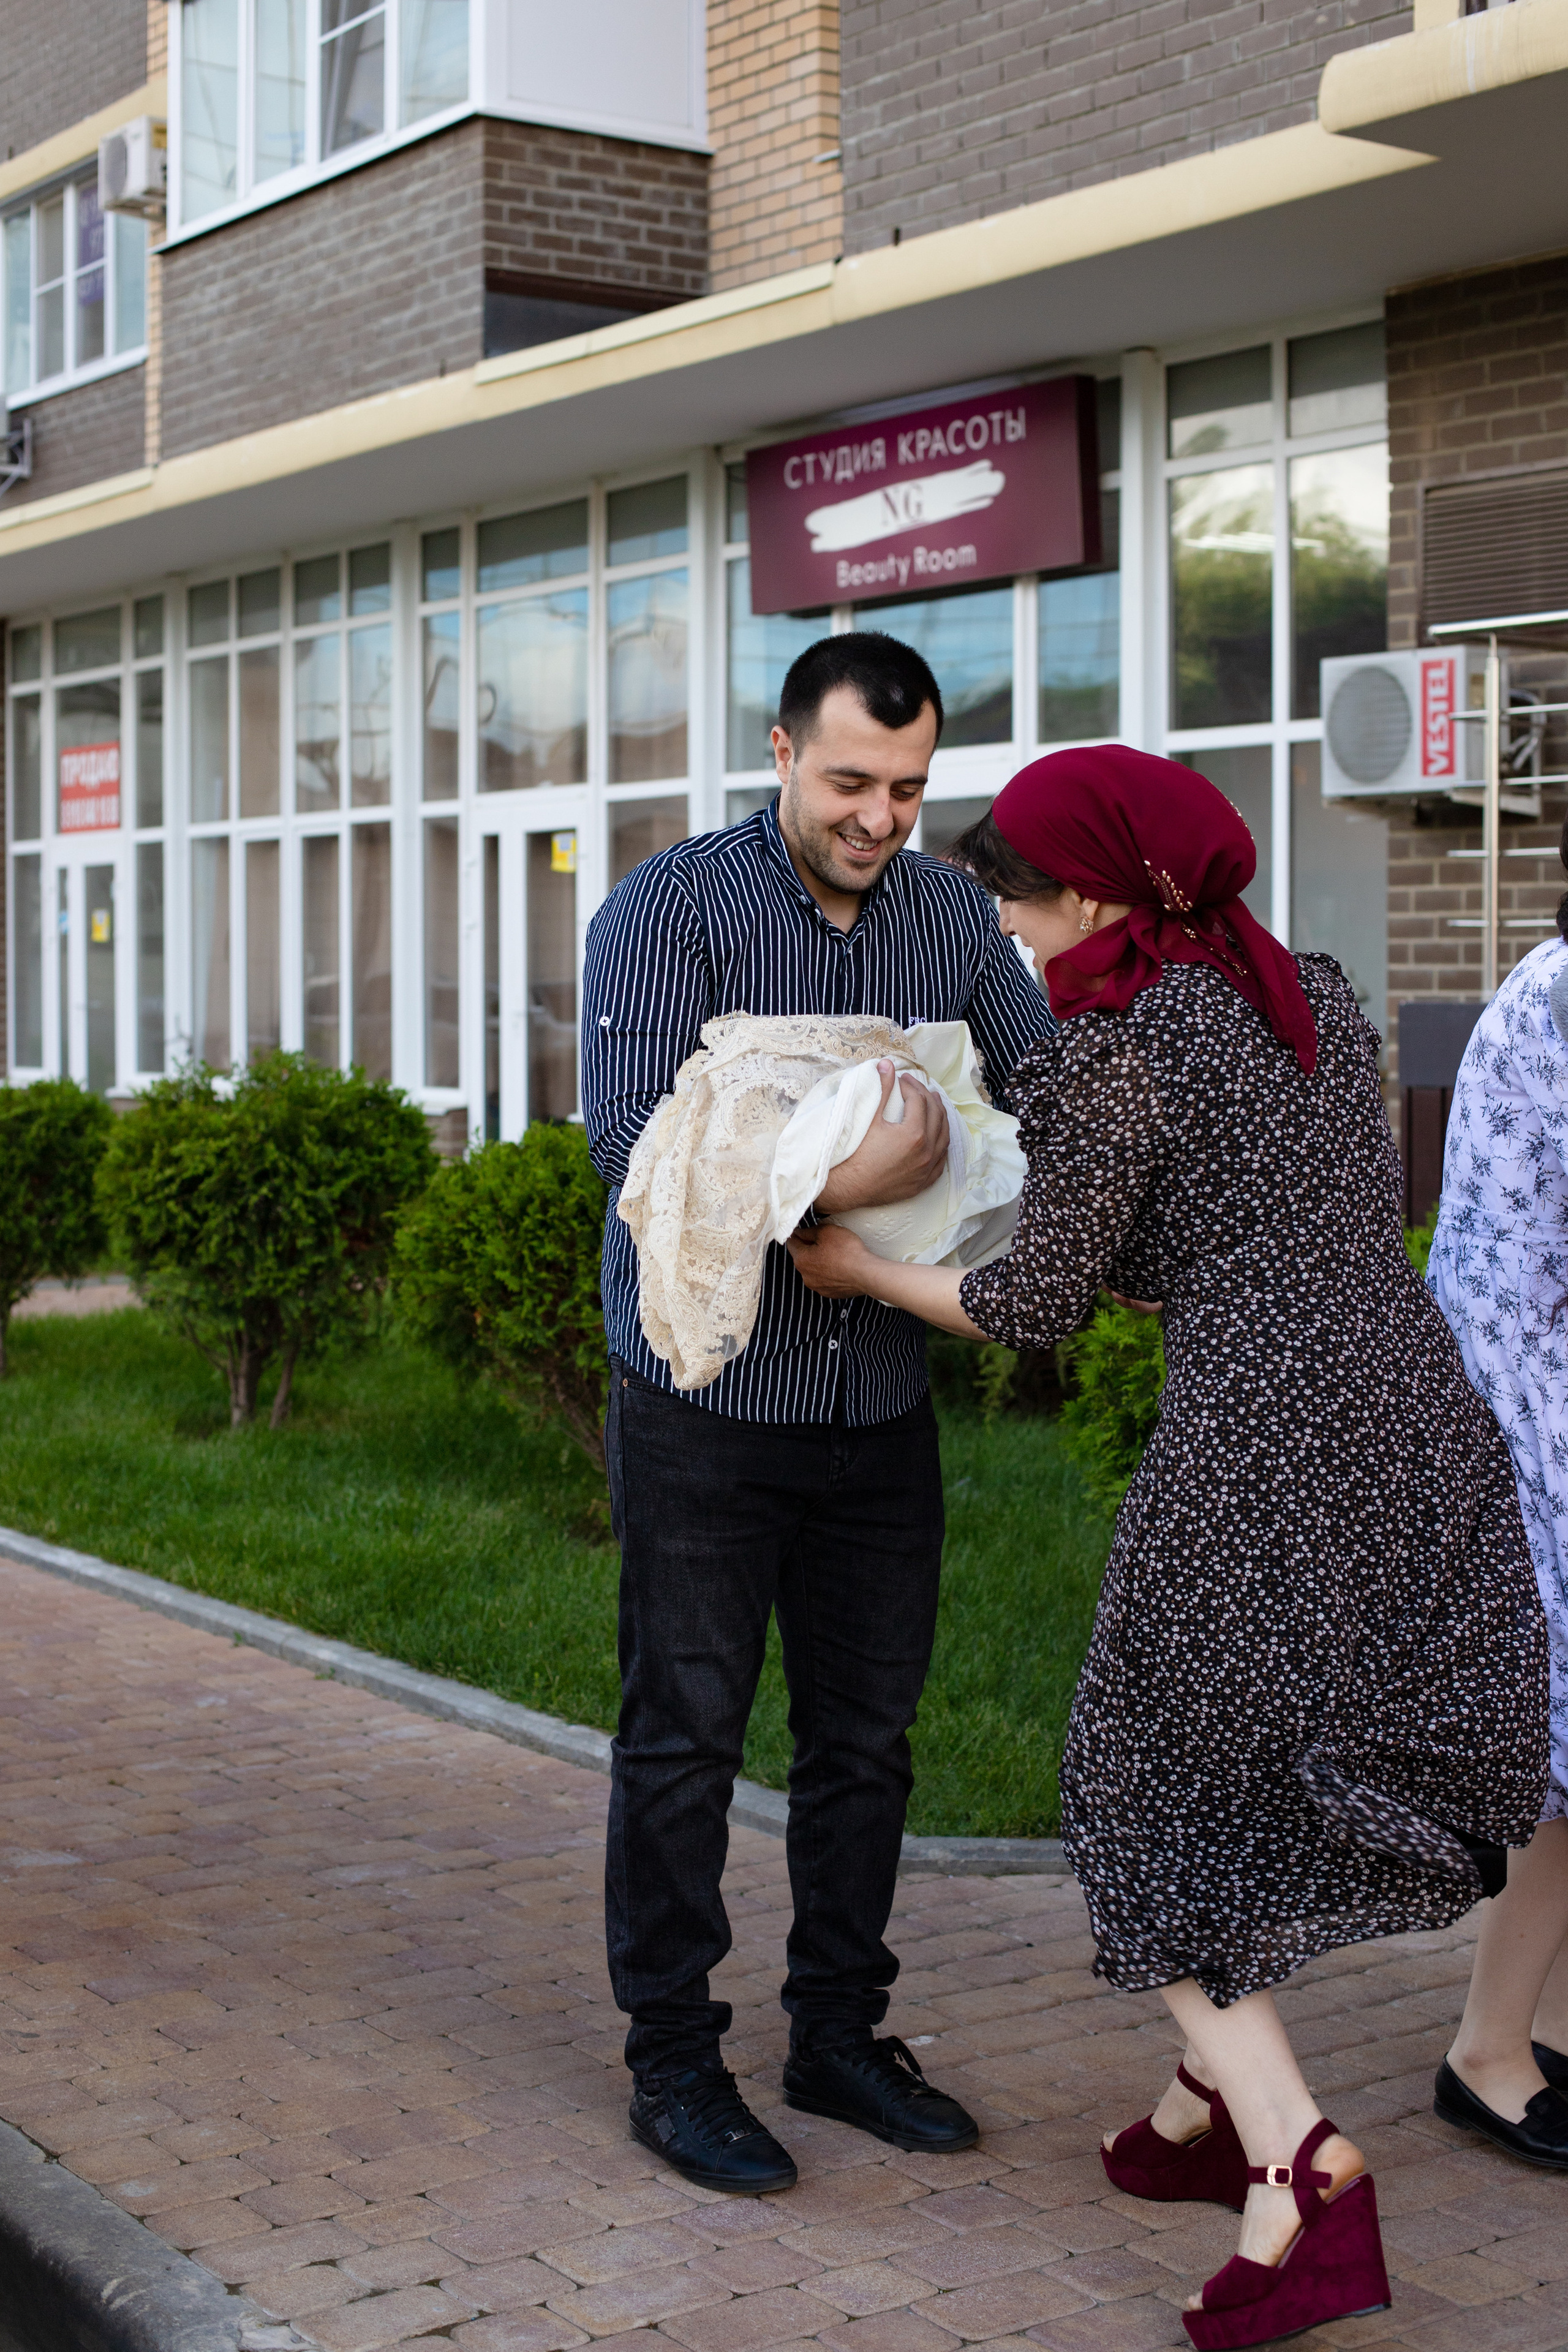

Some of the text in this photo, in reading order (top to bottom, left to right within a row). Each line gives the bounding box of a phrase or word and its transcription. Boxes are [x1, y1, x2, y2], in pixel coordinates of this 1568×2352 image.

[783, 406, 1027, 489] СТУДИЯ КРАСОТЫ
[880, 484, 924, 527] NG
[836, 543, 977, 589] Beauty Room
[1427, 660, 1450, 775] VESTEL
